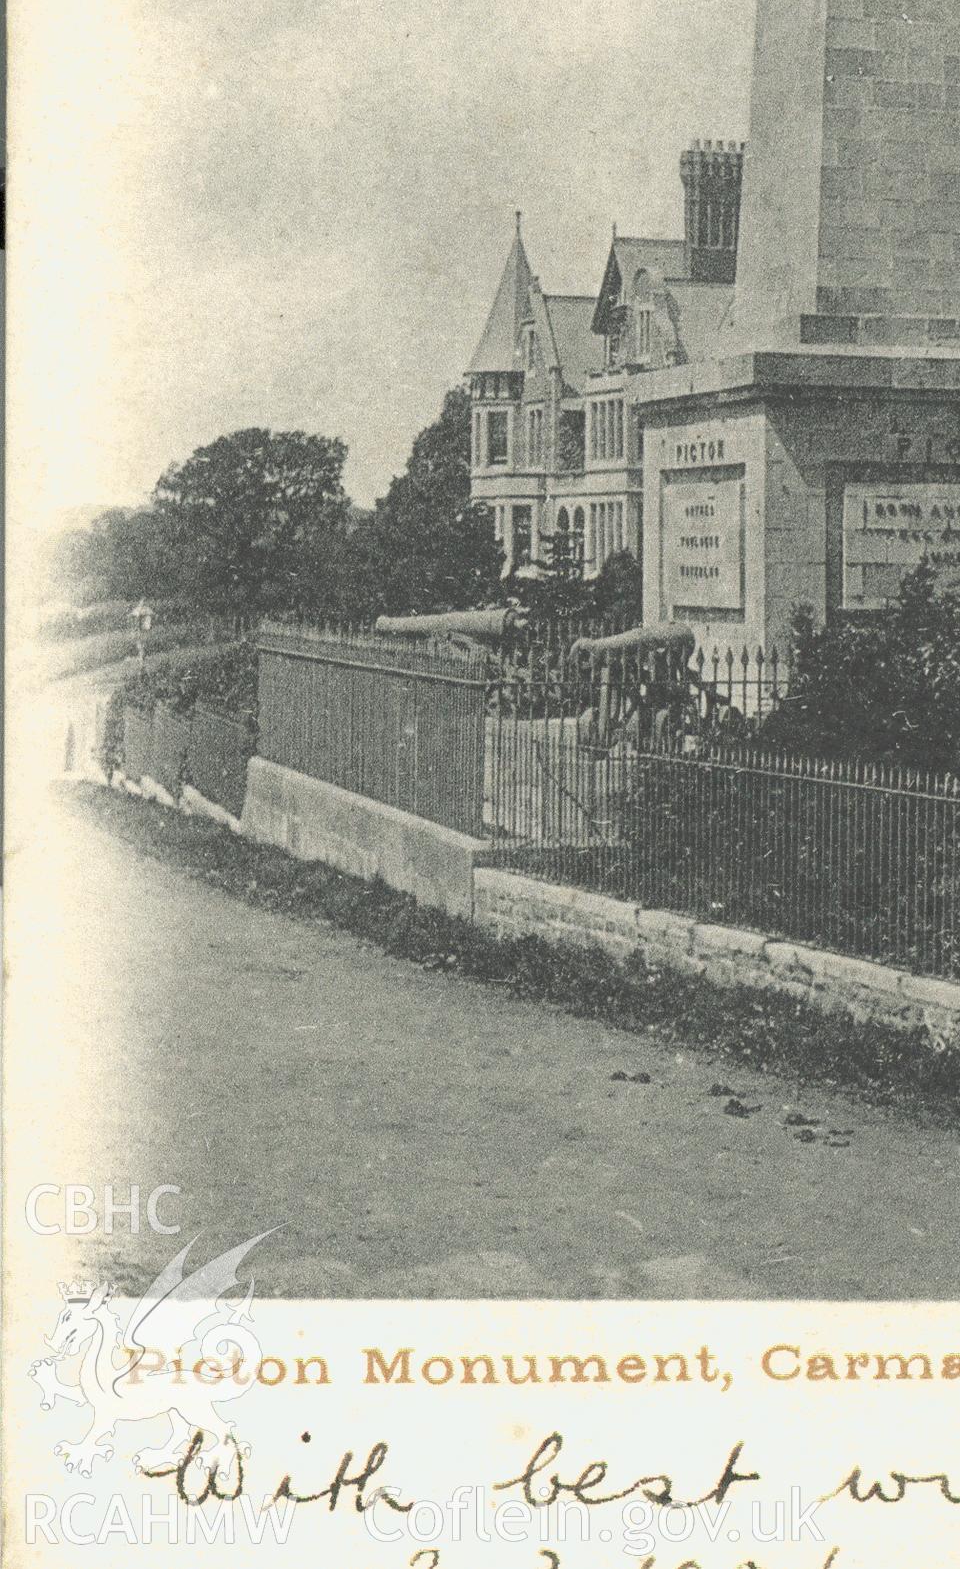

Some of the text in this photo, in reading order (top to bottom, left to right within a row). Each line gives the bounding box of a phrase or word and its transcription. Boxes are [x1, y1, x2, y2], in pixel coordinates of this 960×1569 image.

[676, 439, 724, 462] PICTON
[122, 1346, 333, 1386] Picton
[362, 1345, 733, 1392] Monument,
[142, 1431, 414, 1514] With
[493, 1431, 760, 1508] best
